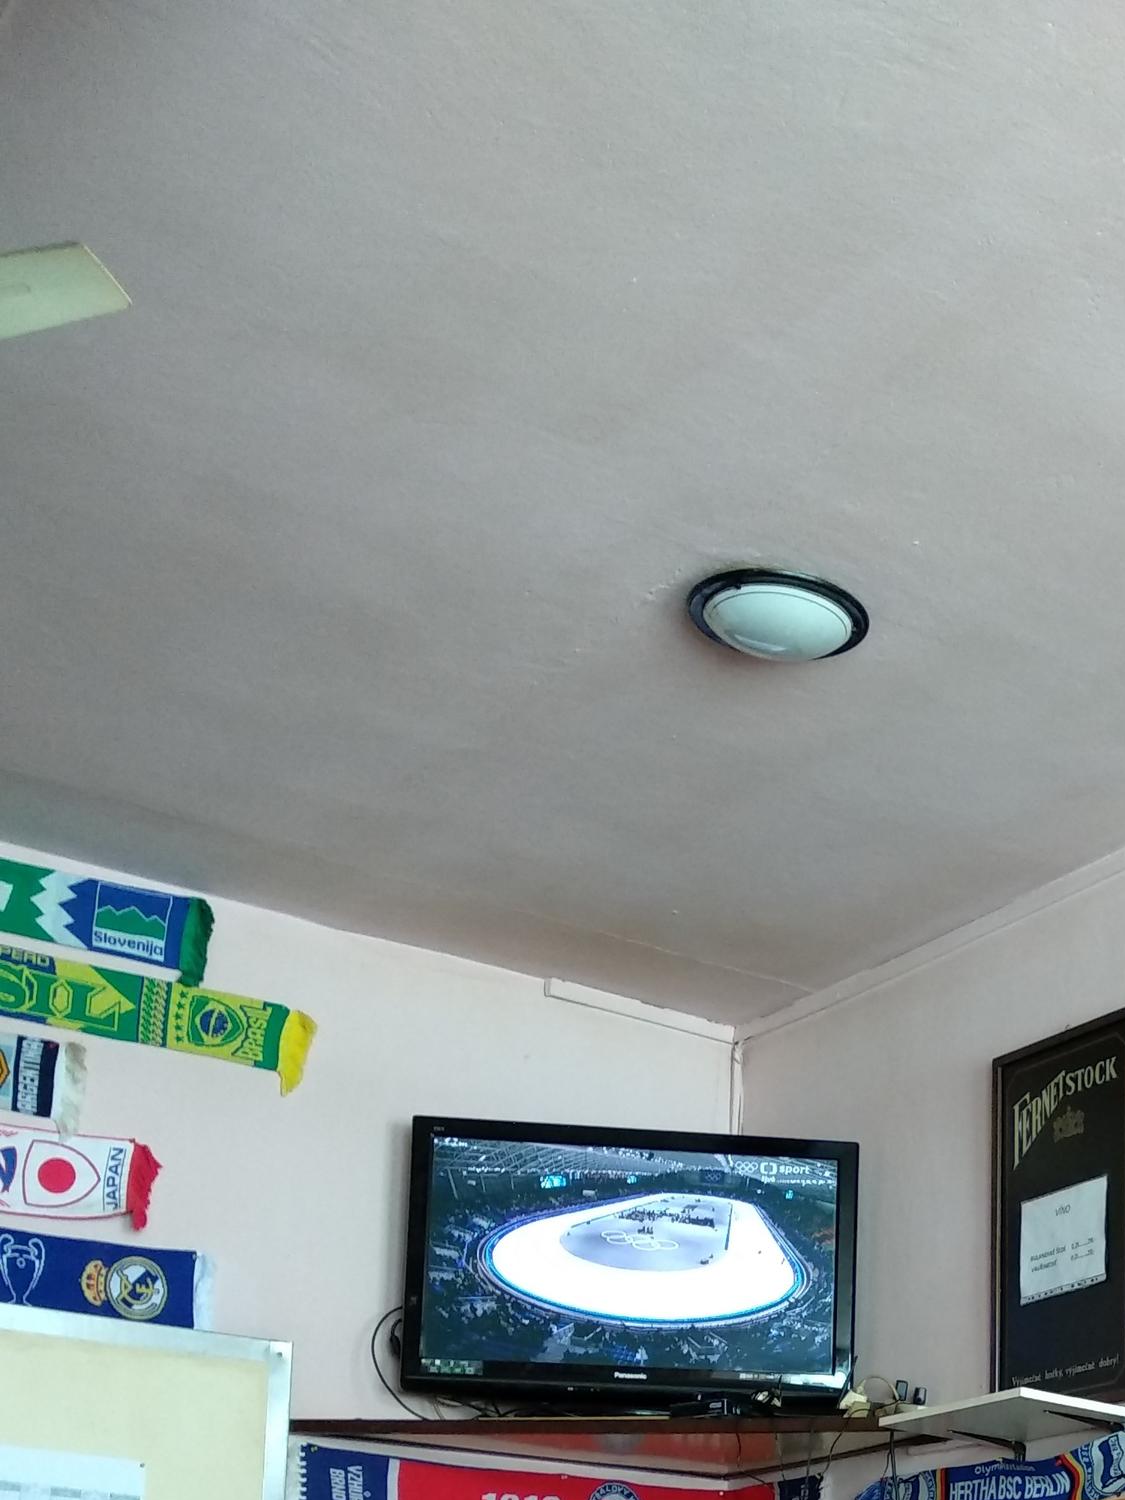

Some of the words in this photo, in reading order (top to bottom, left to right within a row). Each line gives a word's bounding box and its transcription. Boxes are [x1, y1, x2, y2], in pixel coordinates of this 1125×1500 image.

[93, 930, 164, 957] Slovenija
[1013, 1069, 1066, 1171] FERNET
[1065, 1056, 1118, 1095] STOCK
[104, 1146, 125, 1209] JAPAN
[779, 1164, 810, 1175] sport
[998, 1475, 1022, 1500] BSC
[1024, 1471, 1071, 1500] BERLIN
